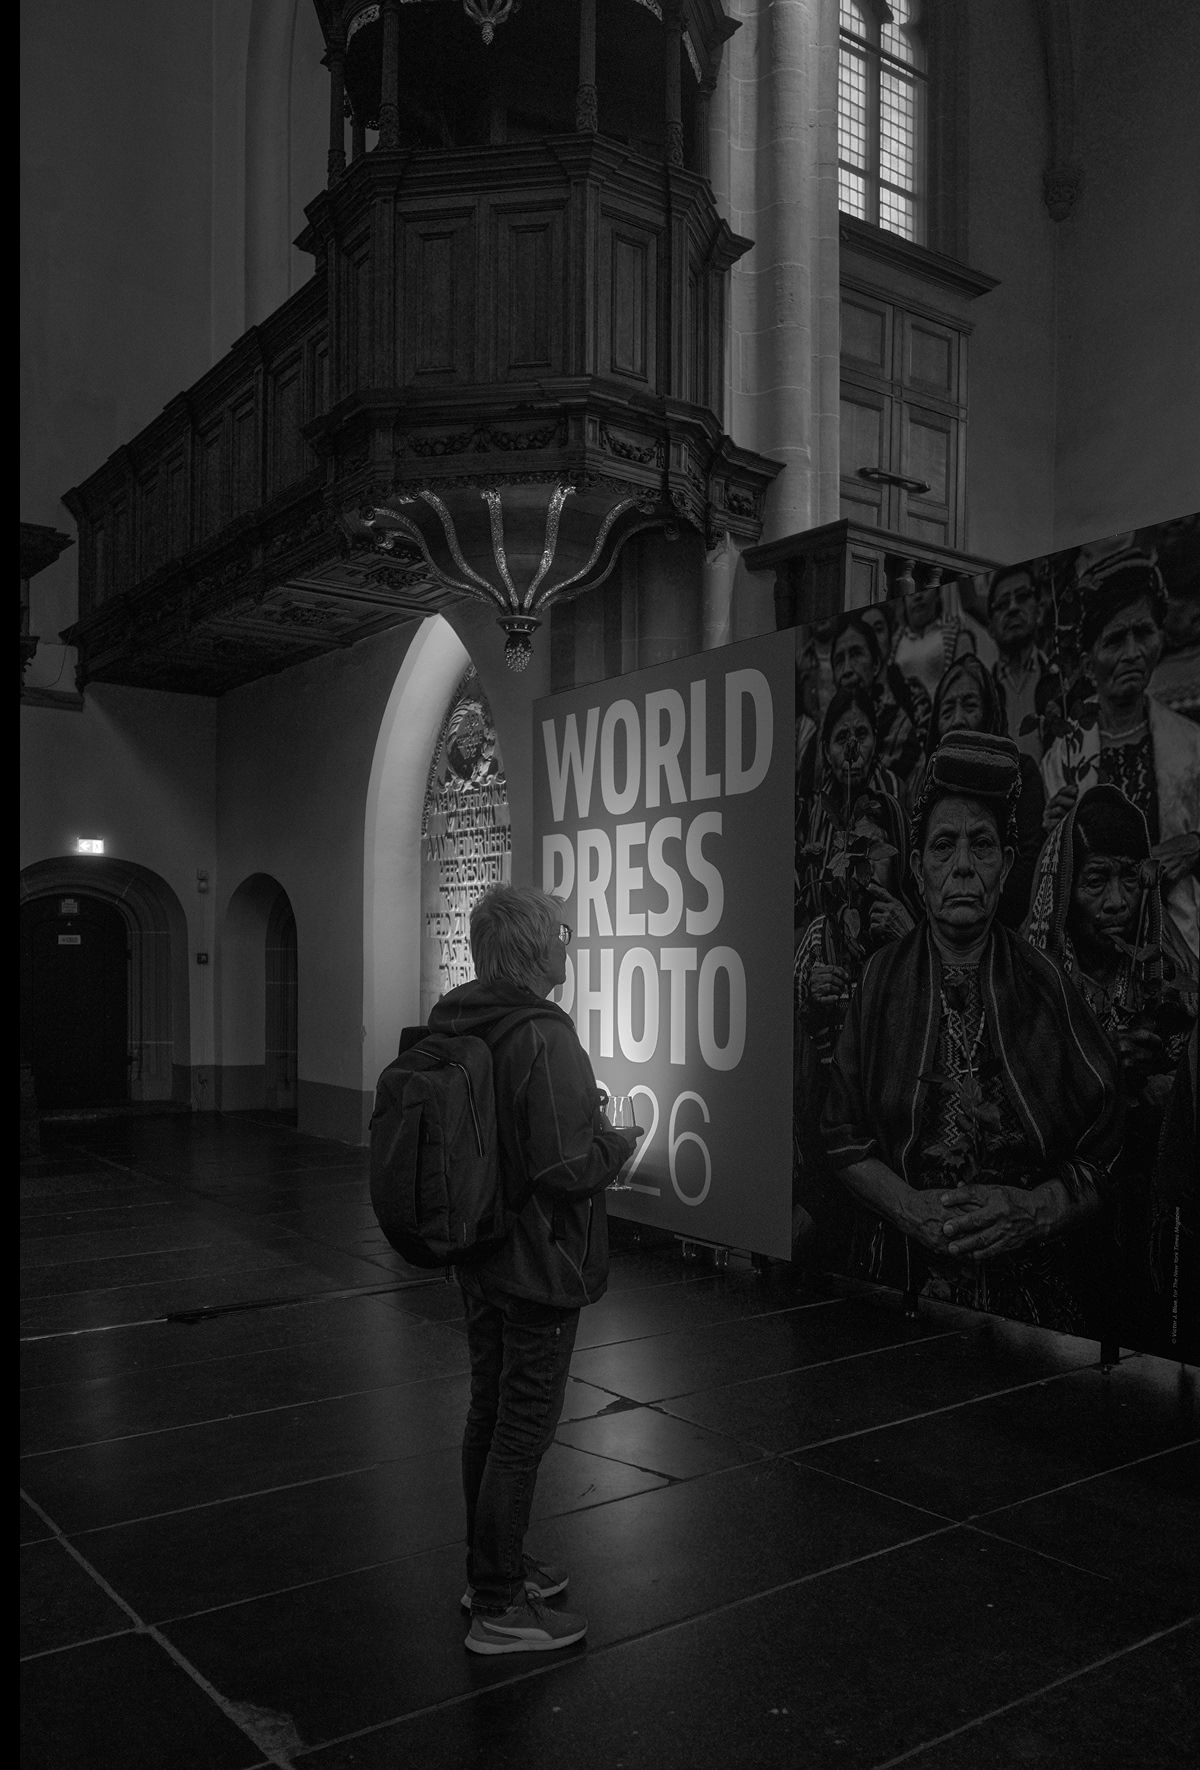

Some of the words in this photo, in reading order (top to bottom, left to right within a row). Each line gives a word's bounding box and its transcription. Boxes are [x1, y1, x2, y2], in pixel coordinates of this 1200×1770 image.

[542, 668, 774, 822] WORLD
[542, 811, 725, 938] PRESS
[597, 1080, 712, 1206] 26
